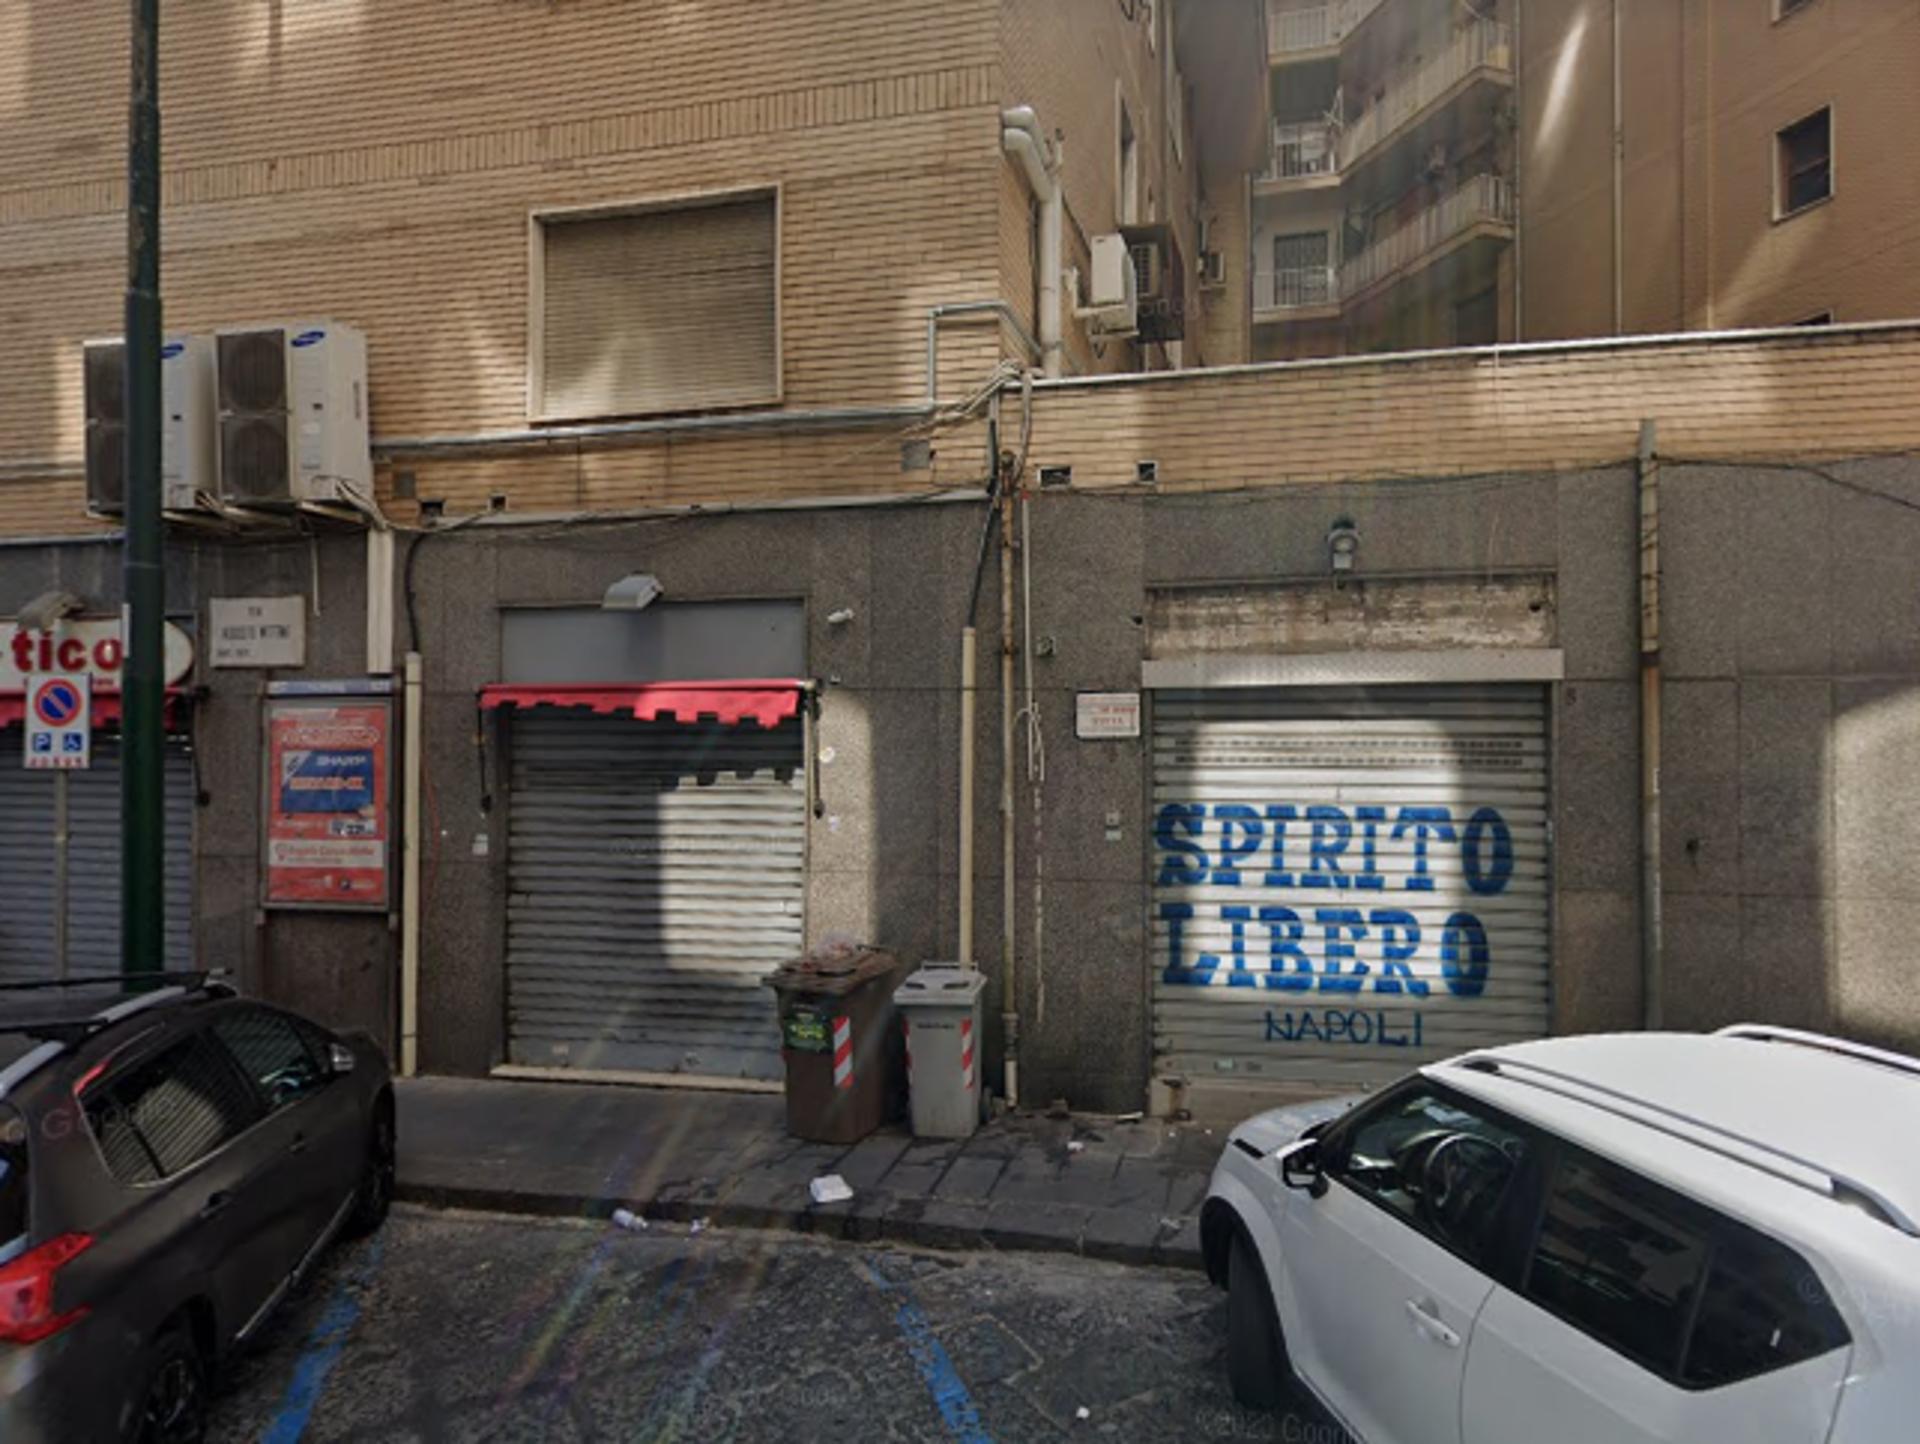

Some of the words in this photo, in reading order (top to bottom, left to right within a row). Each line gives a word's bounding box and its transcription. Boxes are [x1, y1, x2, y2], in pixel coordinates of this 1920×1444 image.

[1153, 803, 1515, 896] SPIRITO
[1161, 903, 1490, 998] LIBERO
[1264, 1010, 1423, 1048] NAPOLI
